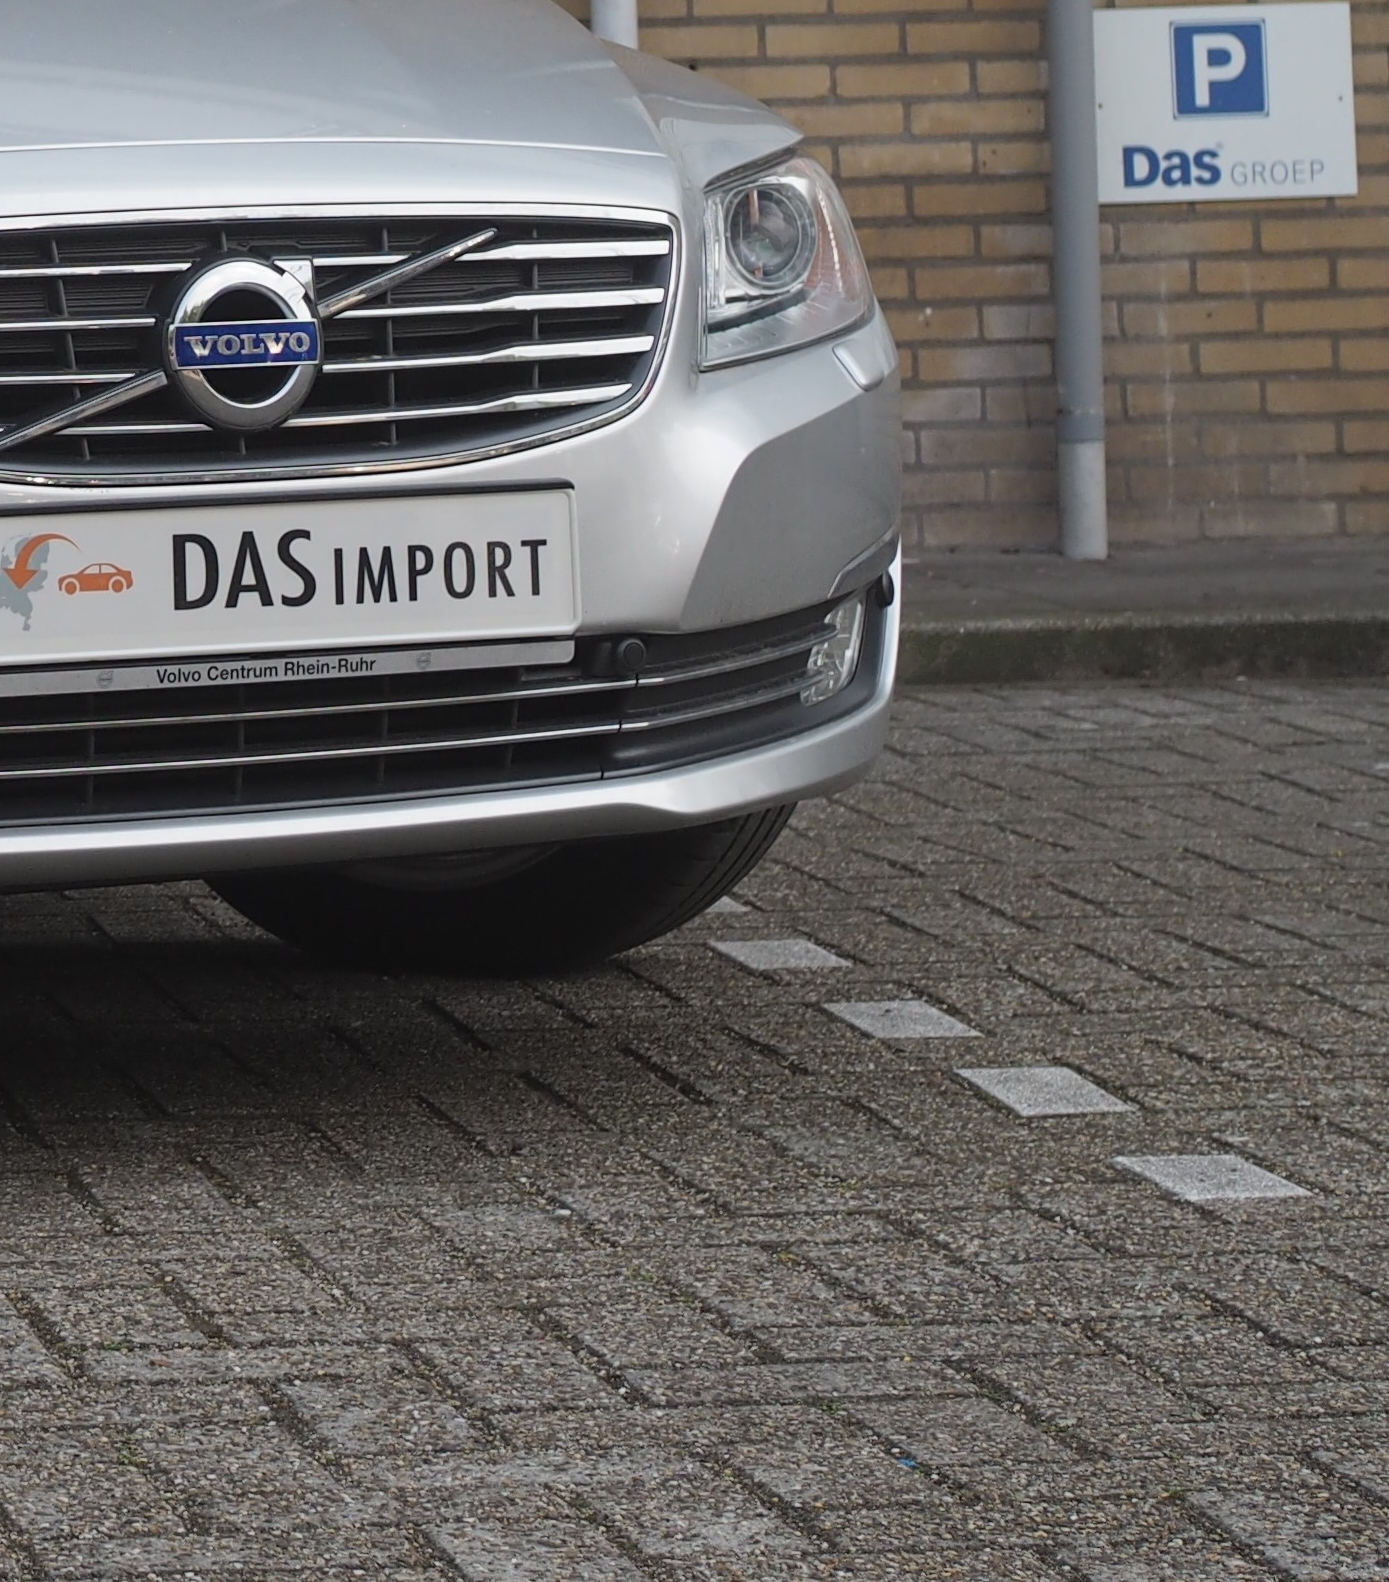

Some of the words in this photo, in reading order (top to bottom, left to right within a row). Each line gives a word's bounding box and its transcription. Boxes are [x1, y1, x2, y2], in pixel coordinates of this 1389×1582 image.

[1192, 33, 1247, 107] P
[1123, 145, 1222, 188] Das
[1230, 159, 1325, 187] GROEP
[183, 331, 311, 358] VOLVO
[172, 528, 317, 611] DAS
[333, 538, 548, 606] IMPORT
[156, 668, 202, 684] Volvo
[207, 664, 279, 681] Centrum
[284, 656, 377, 677] Rhein-Ruhr
